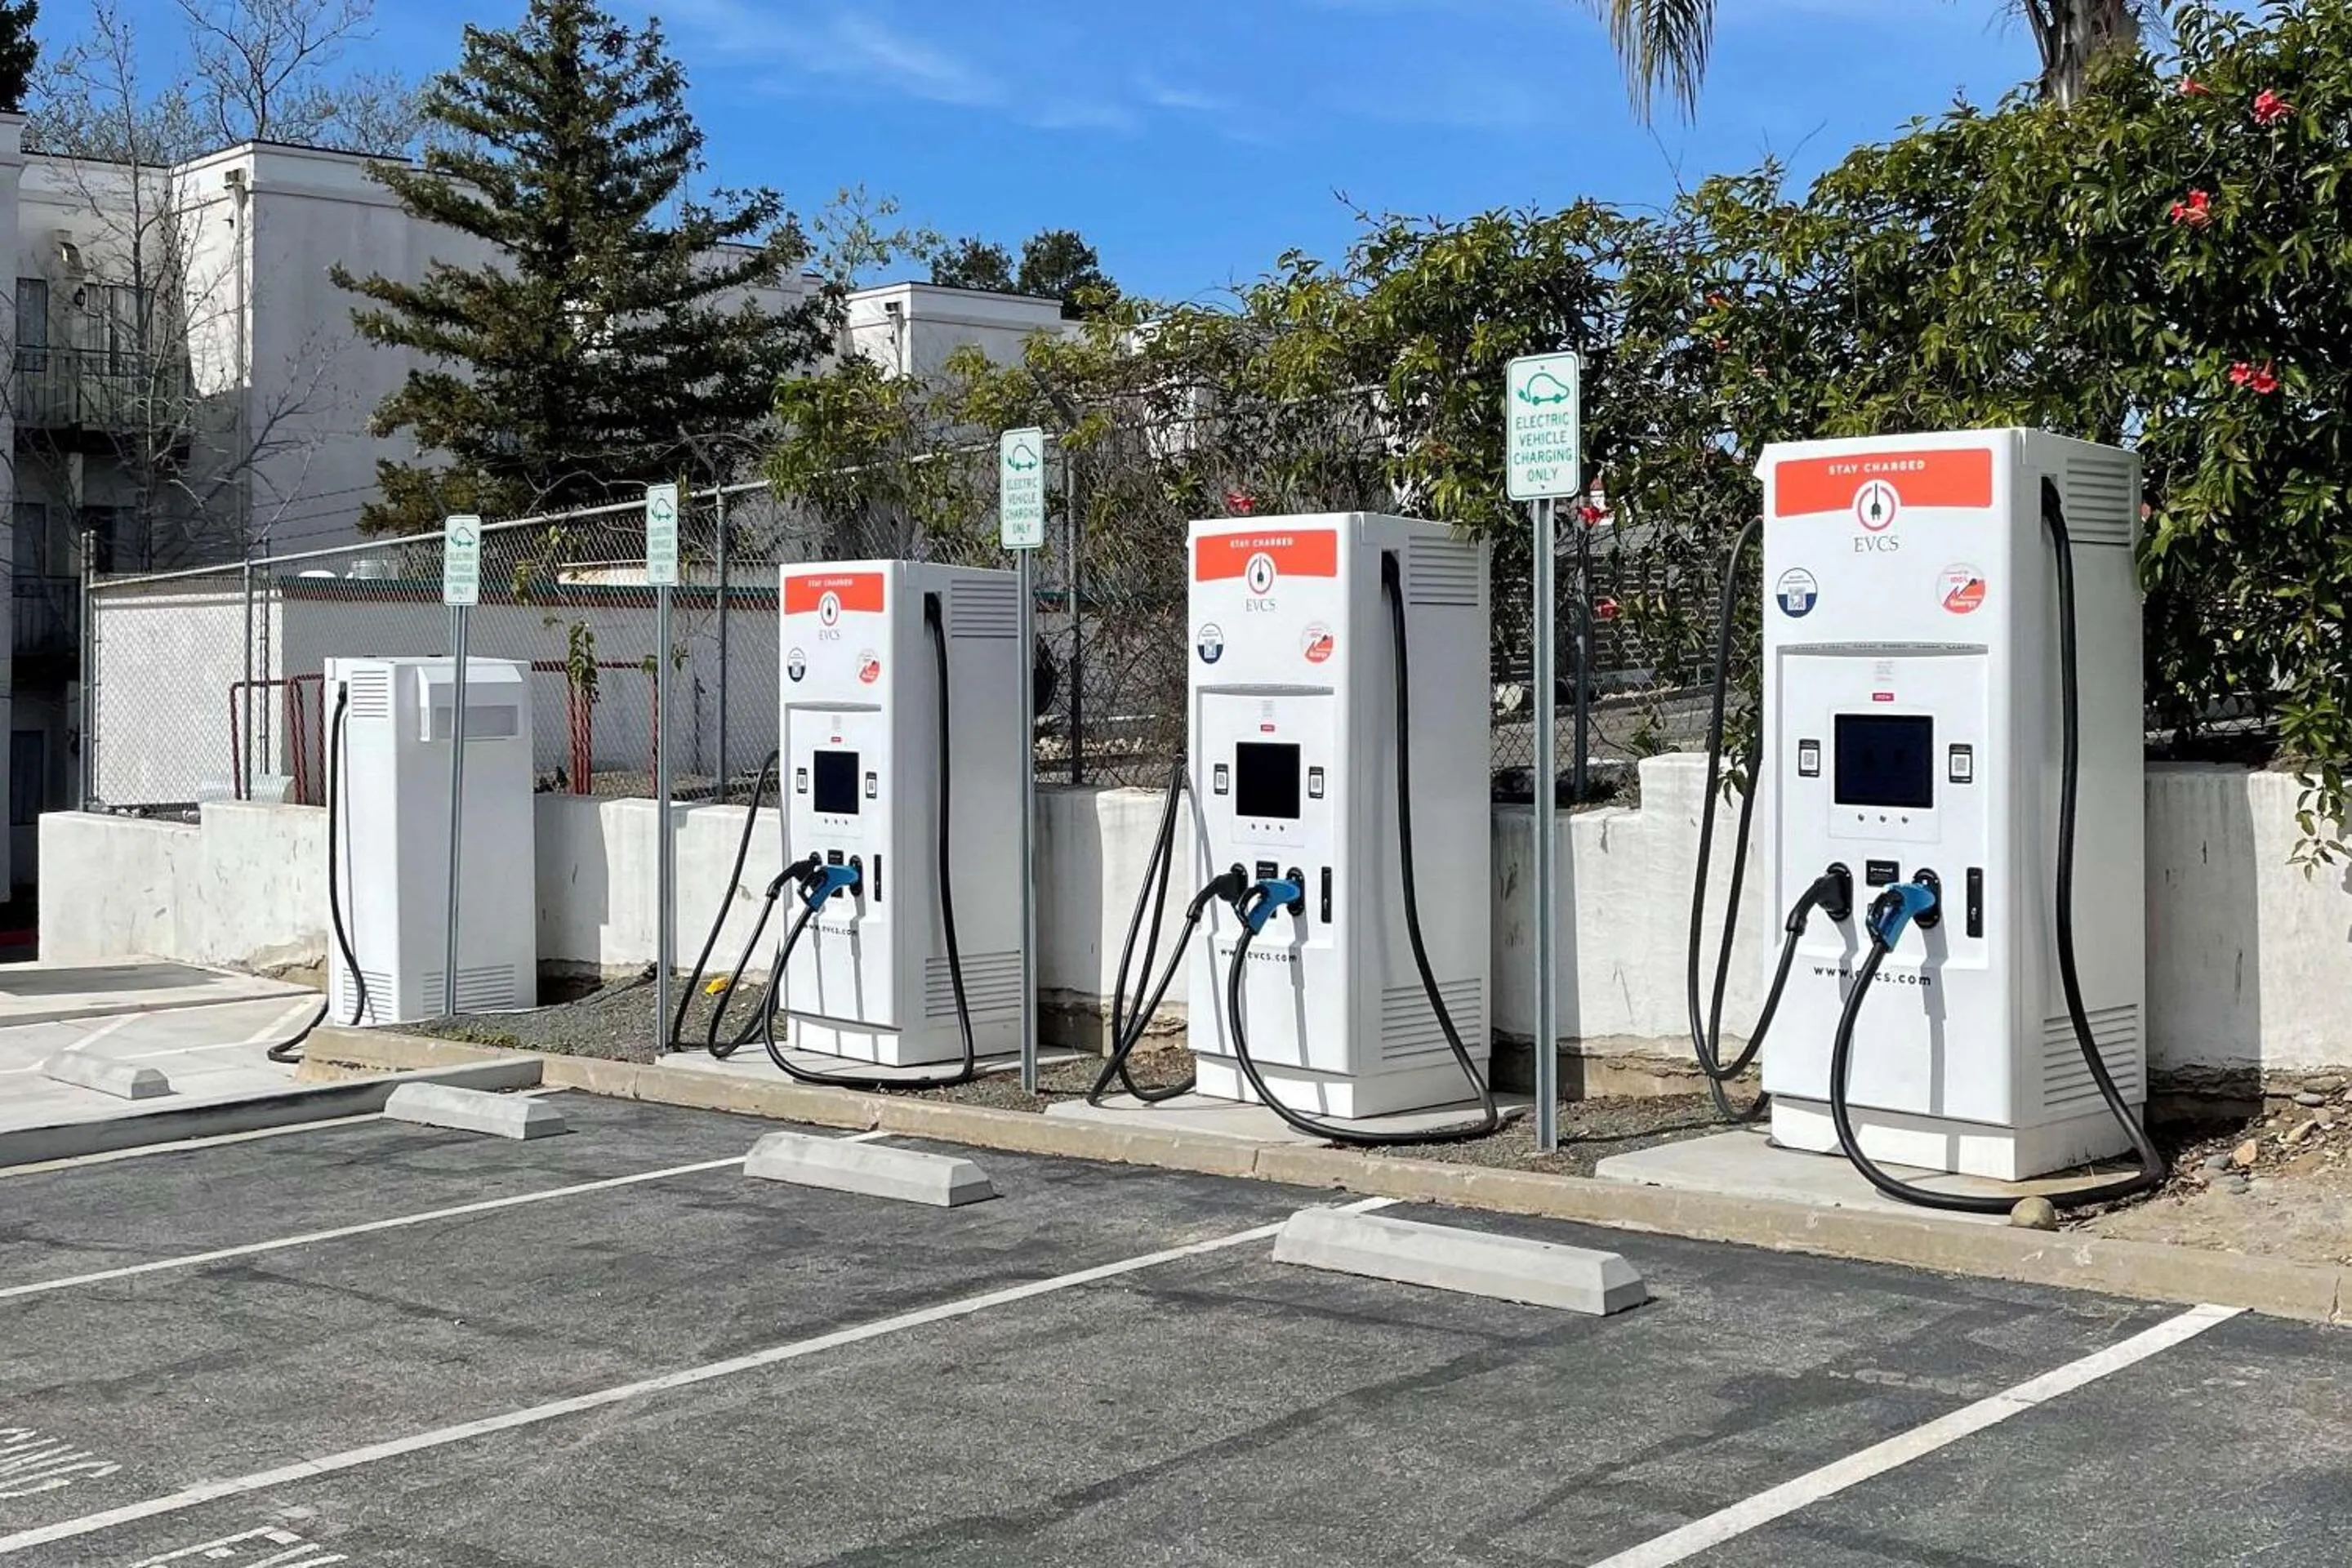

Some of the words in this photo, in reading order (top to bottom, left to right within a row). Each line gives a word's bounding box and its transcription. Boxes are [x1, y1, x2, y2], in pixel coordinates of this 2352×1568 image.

[1517, 412, 1569, 429] ELECTRIC
[1519, 430, 1568, 447] VEHICLE
[1514, 448, 1573, 465] CHARGING
[1526, 468, 1558, 482] ONLY
[1829, 464, 1858, 475] STAY
[1863, 460, 1926, 474] CHARGED
[1853, 535, 1900, 553] EVCS
[1245, 598, 1276, 612] EVCS
